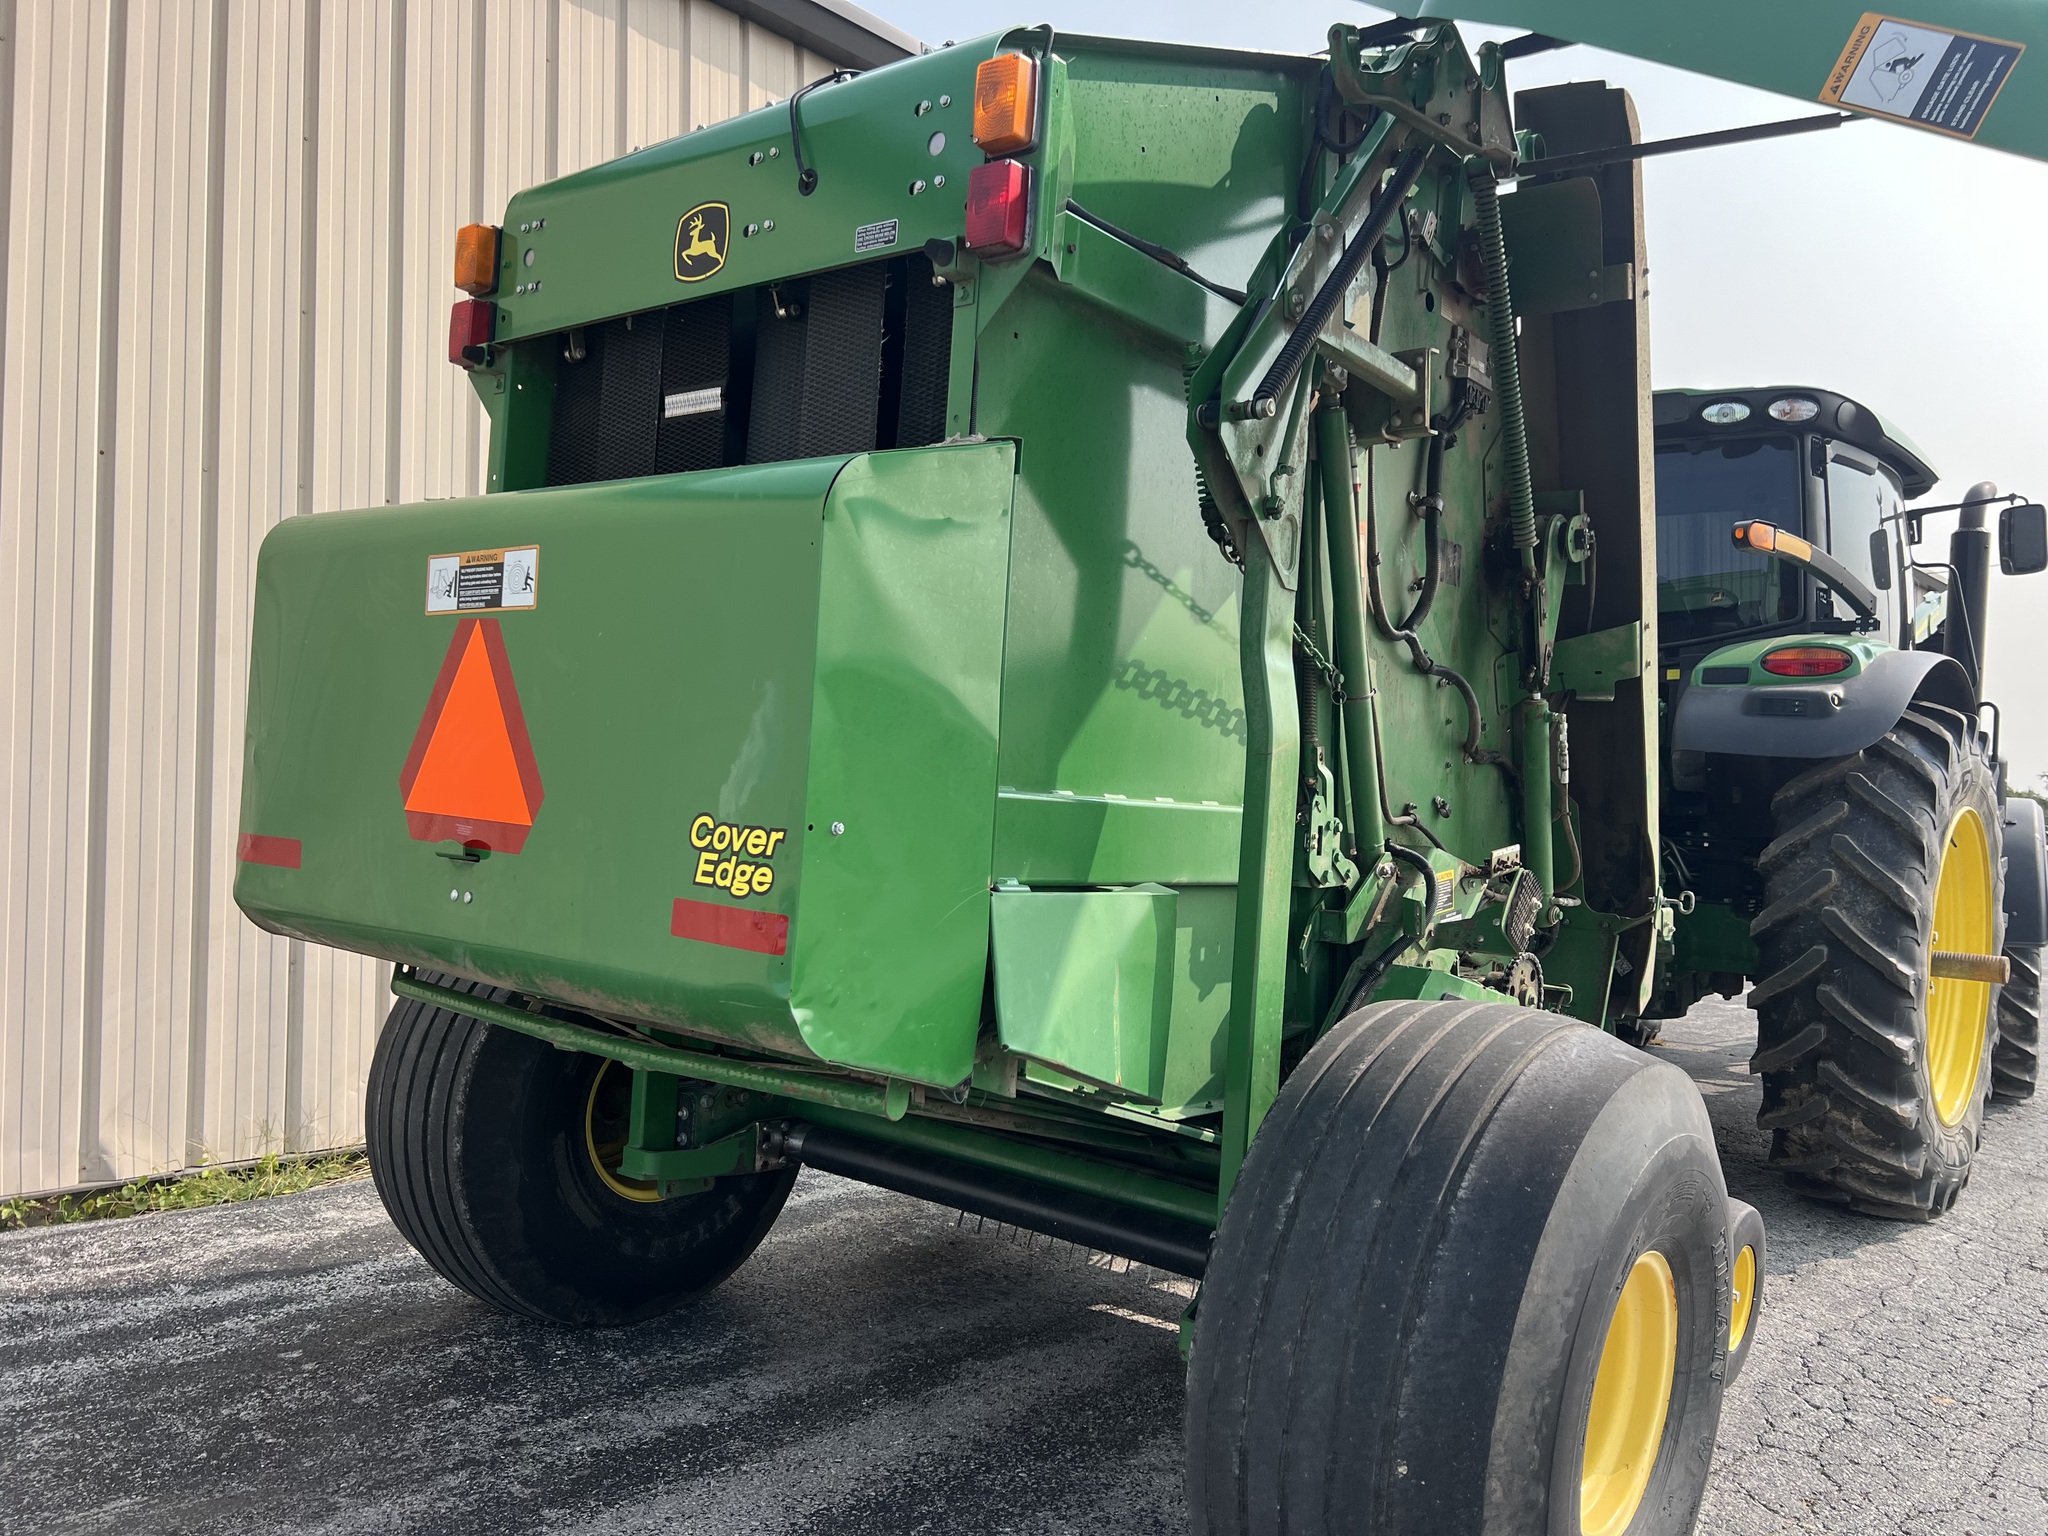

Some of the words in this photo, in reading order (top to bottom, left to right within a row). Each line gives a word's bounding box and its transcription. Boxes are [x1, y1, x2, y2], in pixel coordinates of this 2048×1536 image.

[1837, 25, 1871, 83] WARNING
[1921, 91, 1941, 119] ENGAGE
[1936, 72, 1951, 91] GATE
[1947, 52, 1962, 72] LOCK
[1950, 104, 1967, 127] STAND
[1963, 80, 1981, 104] CLEAR
[470, 553, 498, 564] WARNING
[690, 814, 786, 857] Cover
[694, 851, 774, 898] Edge
